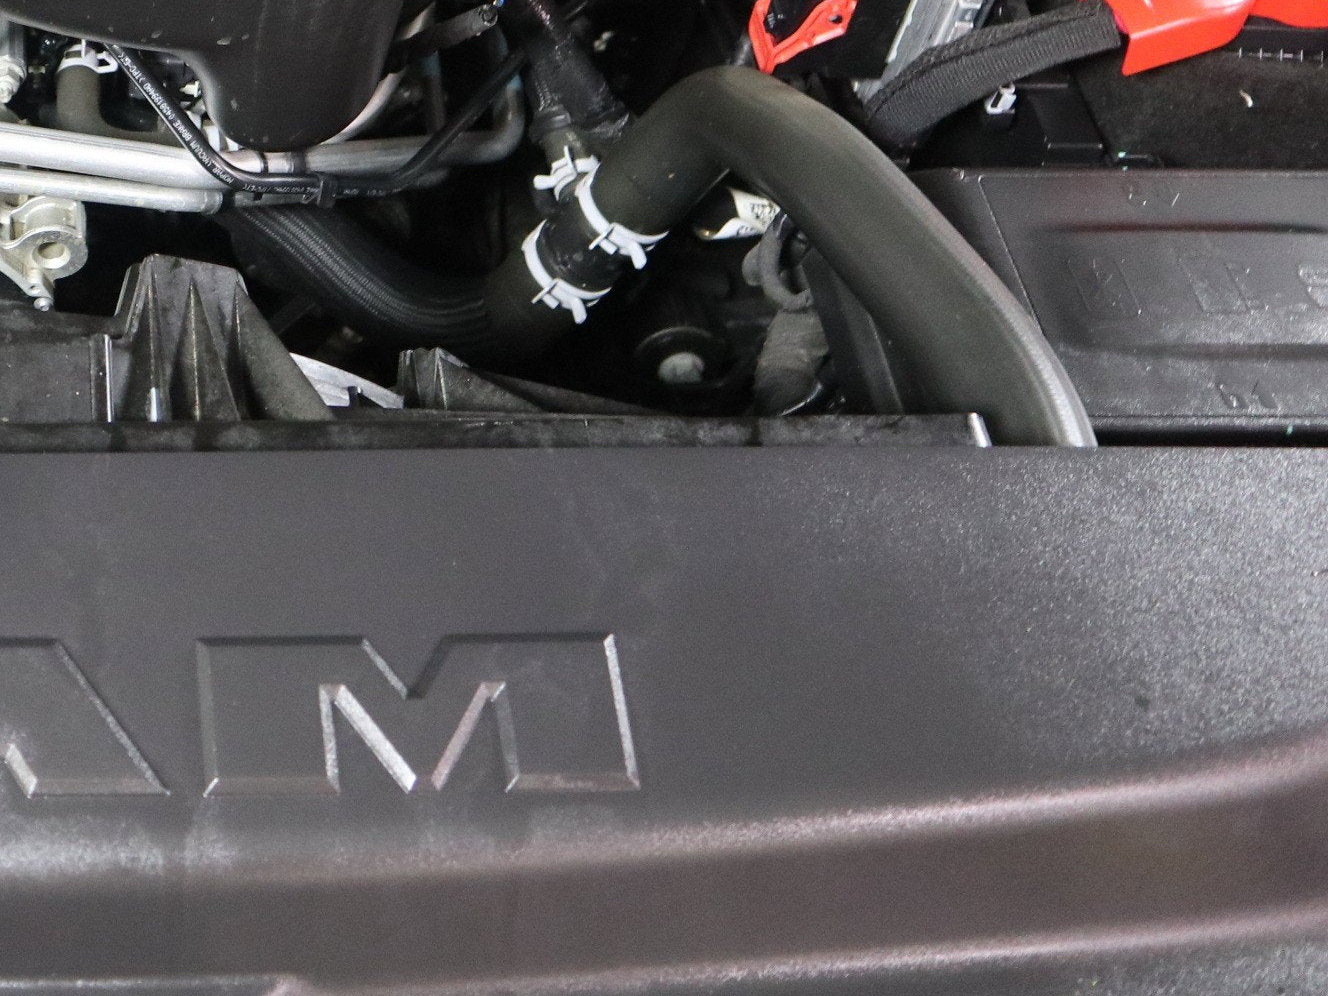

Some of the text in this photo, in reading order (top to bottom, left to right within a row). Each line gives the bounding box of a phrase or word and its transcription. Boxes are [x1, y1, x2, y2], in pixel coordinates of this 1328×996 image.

[172, 120, 193, 143] BRAKE
[189, 139, 213, 168] VACUUM
[212, 165, 234, 185] MOPAR
